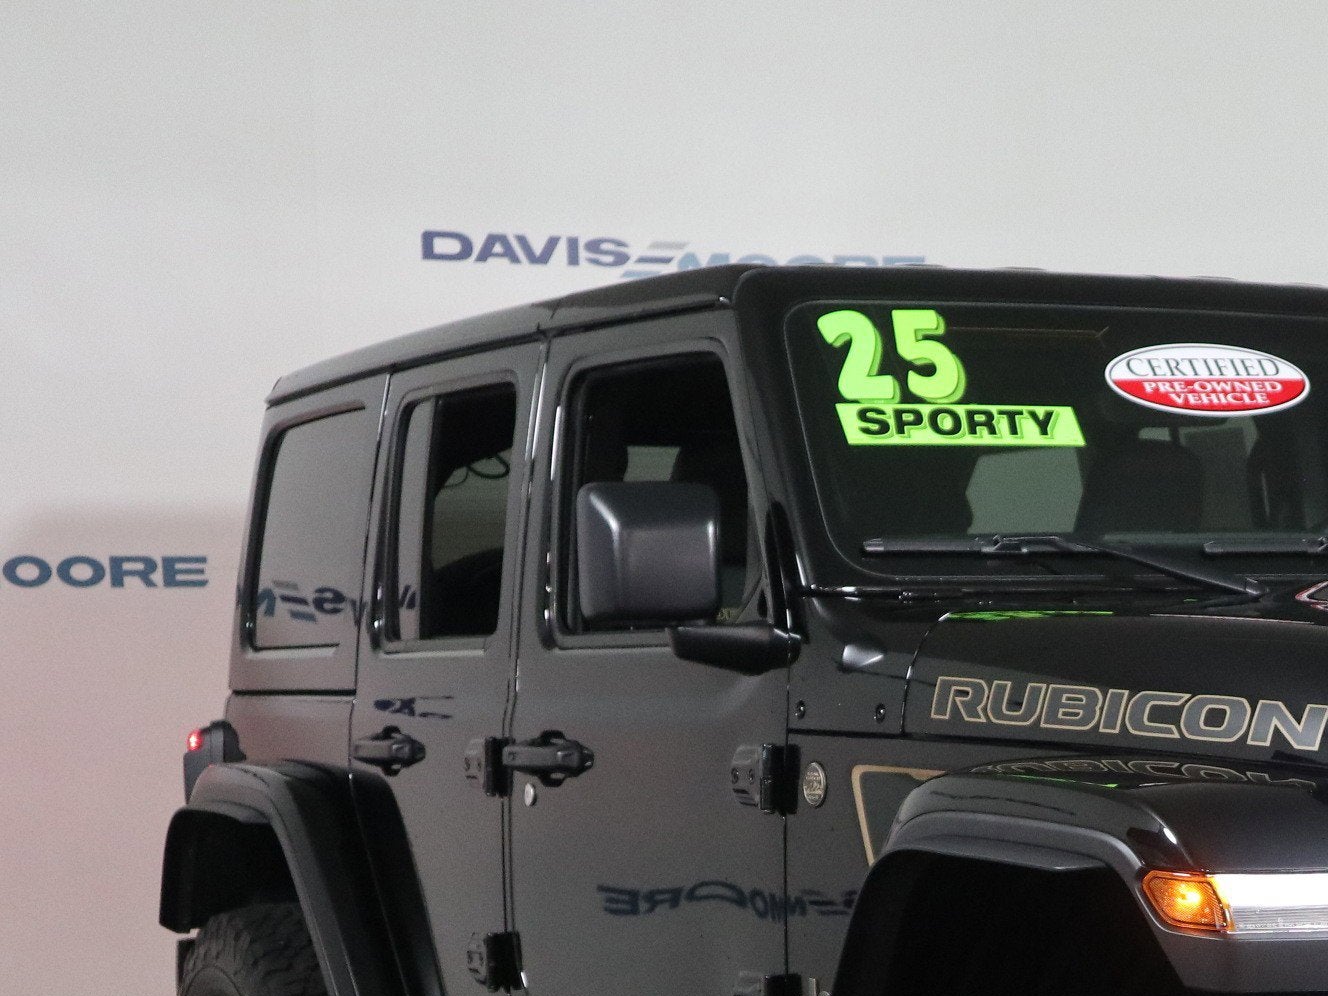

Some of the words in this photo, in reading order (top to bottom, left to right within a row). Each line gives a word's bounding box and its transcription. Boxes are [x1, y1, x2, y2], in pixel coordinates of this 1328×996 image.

[421, 230, 631, 266] DAVIS
[817, 310, 967, 404] 25
[1126, 358, 1279, 376] CERTIFIED
[1142, 381, 1283, 393] PRE-OWNED
[1169, 393, 1270, 404] VEHICLE
[857, 407, 1059, 438] SPORTY
